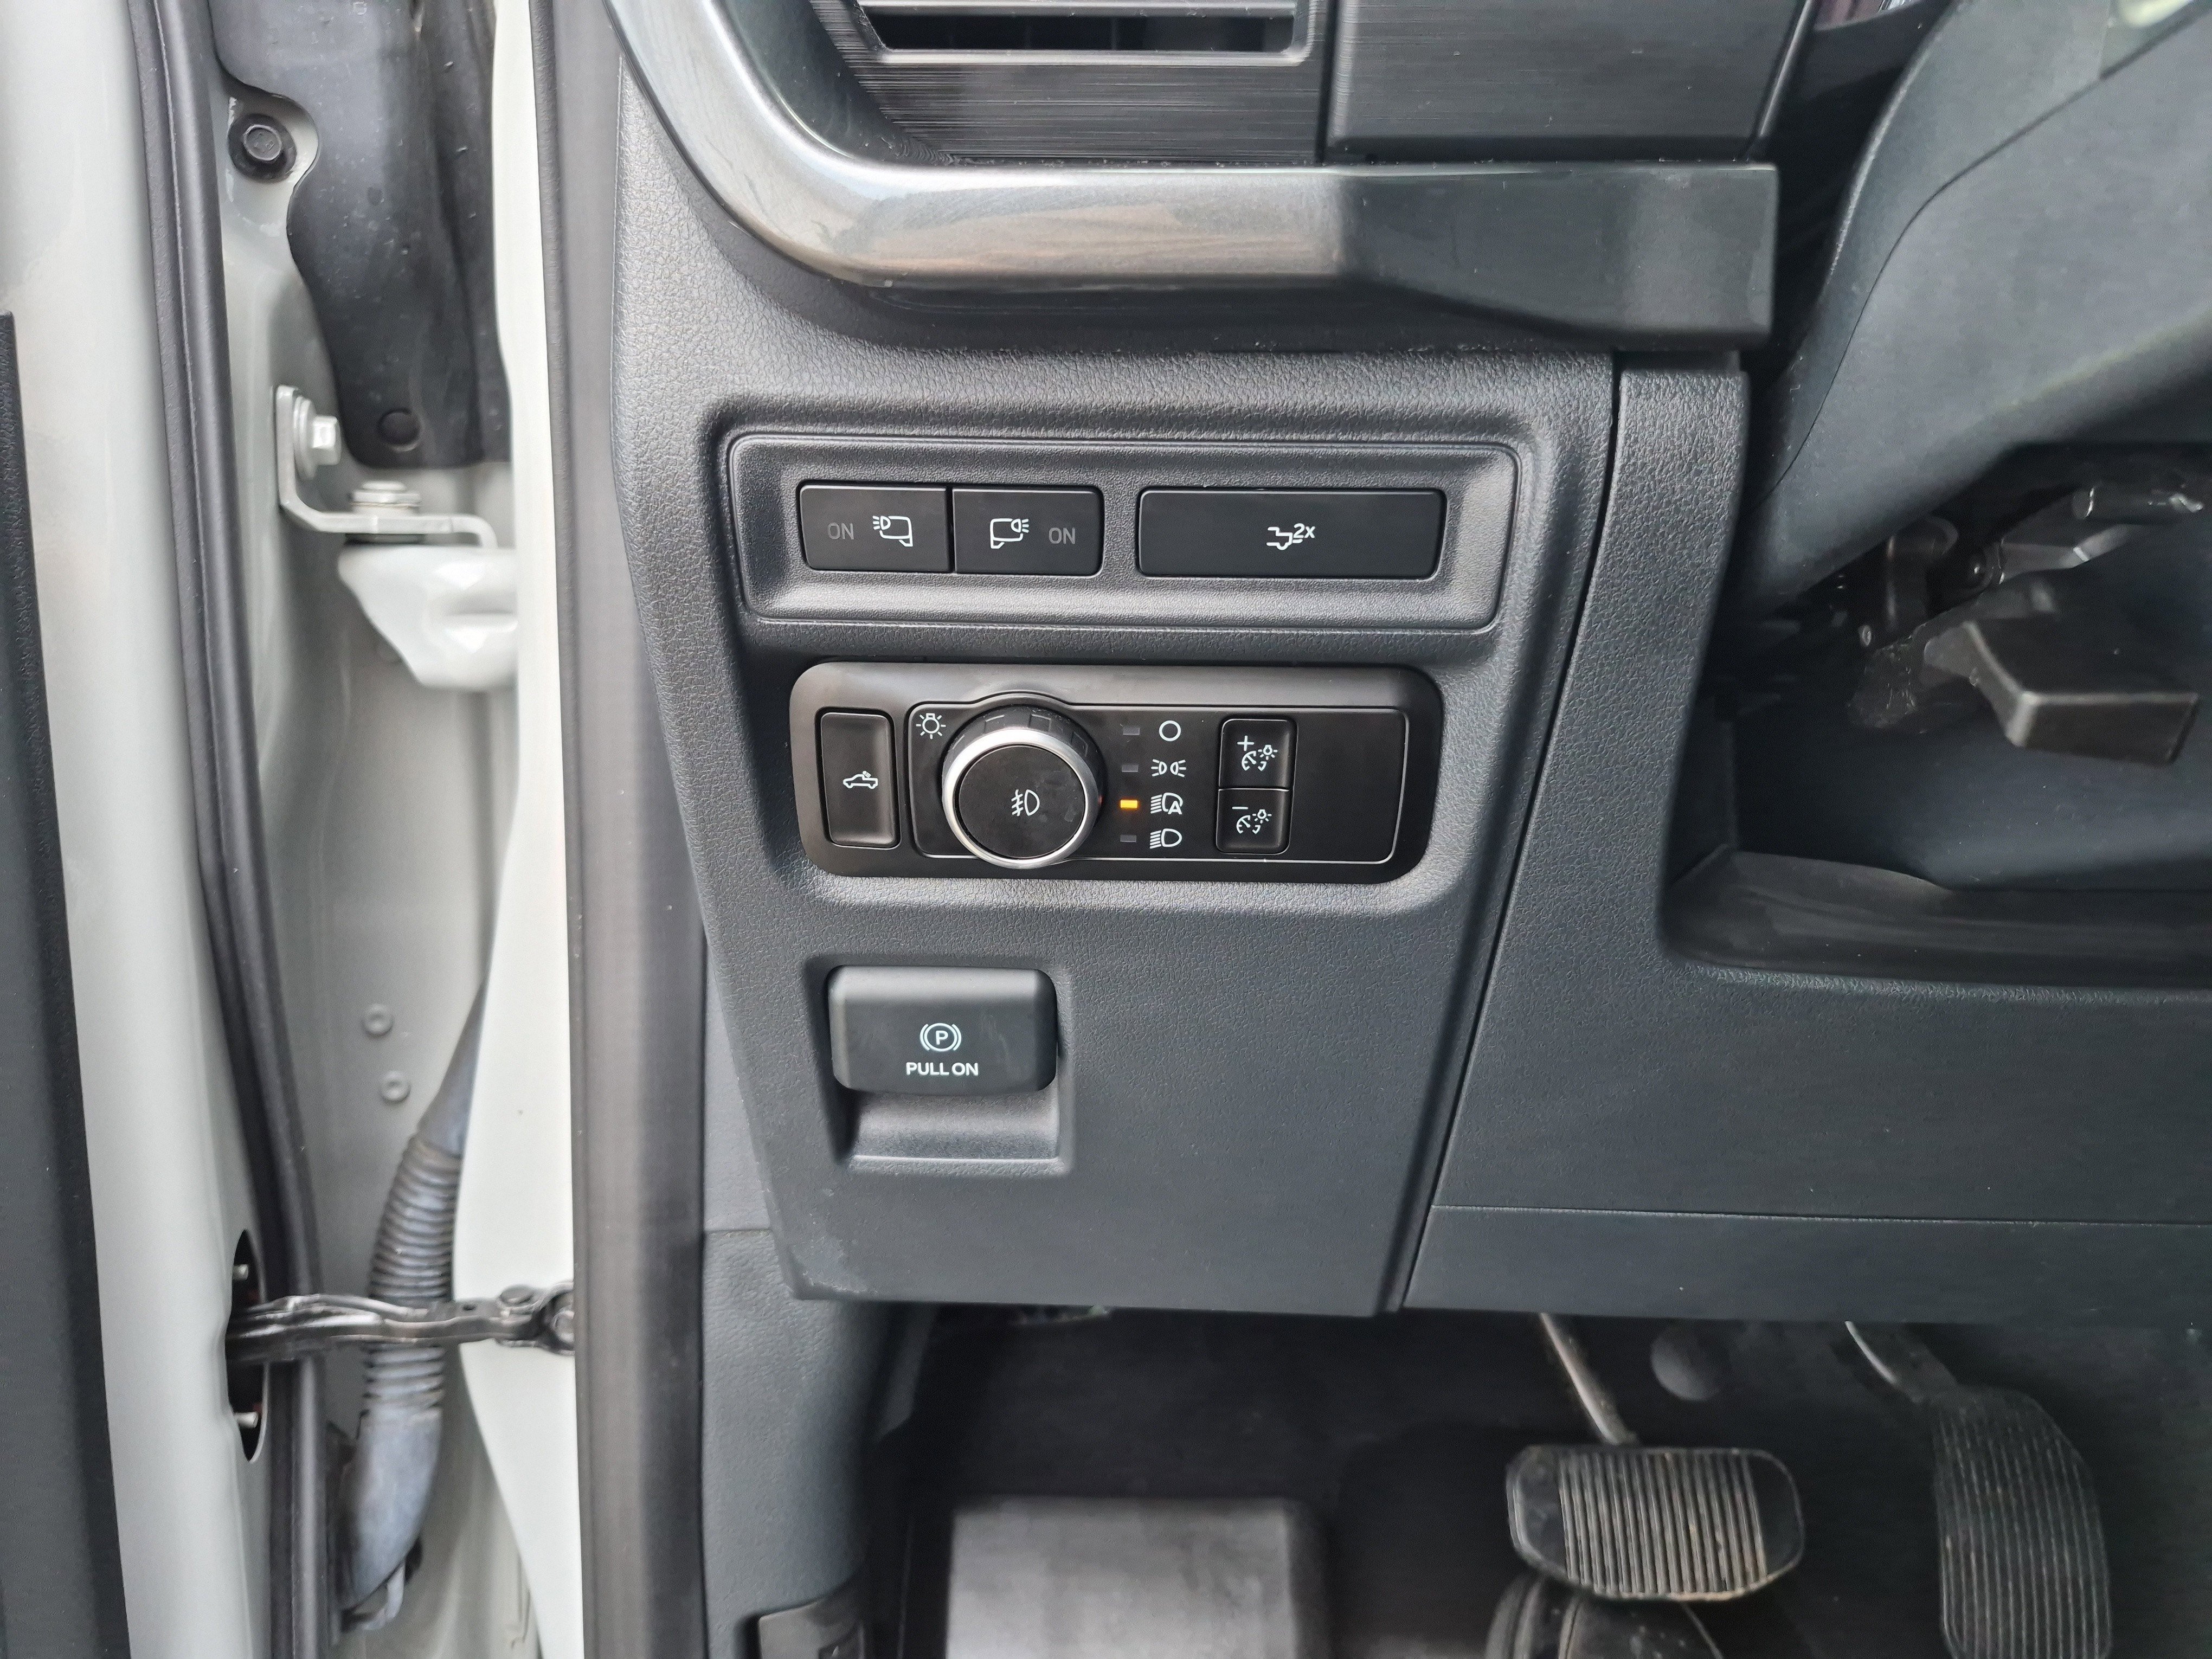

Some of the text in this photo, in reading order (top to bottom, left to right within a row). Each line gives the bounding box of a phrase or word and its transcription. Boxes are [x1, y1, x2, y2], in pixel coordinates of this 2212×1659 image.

[827, 522, 854, 541] ON
[1048, 527, 1076, 545] ON
[935, 1030, 949, 1045] P
[905, 1062, 979, 1076] PULL ON
